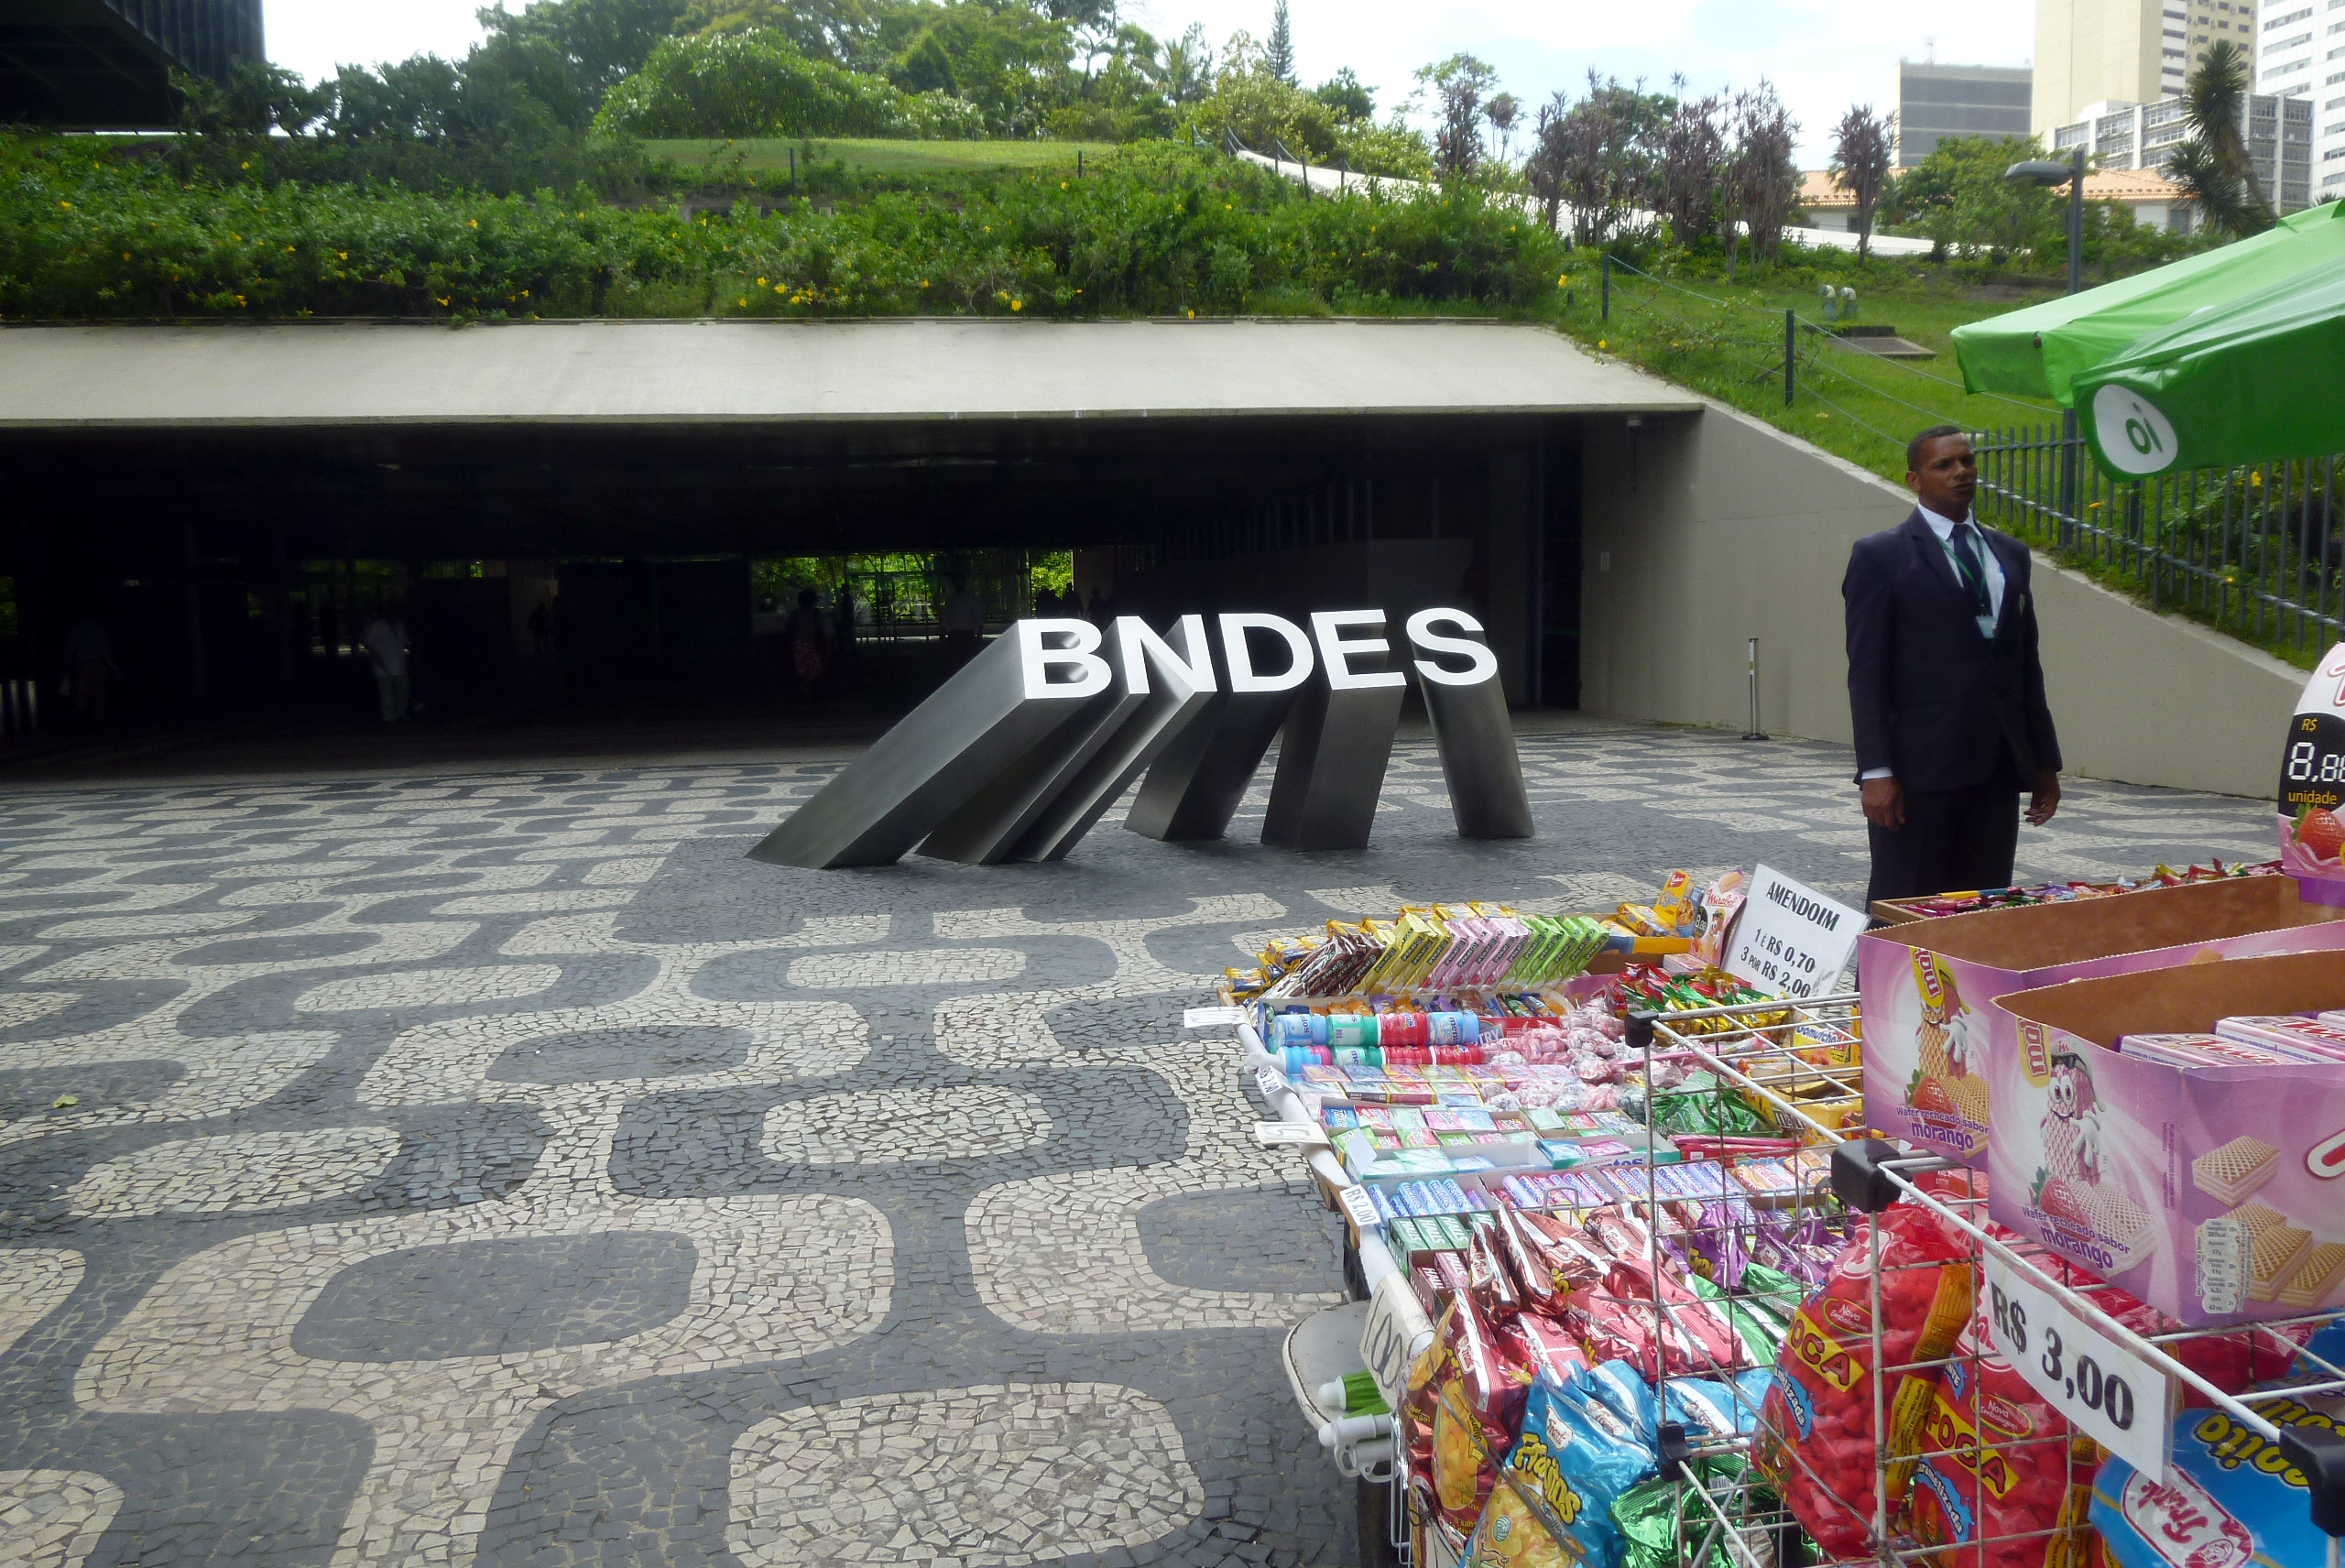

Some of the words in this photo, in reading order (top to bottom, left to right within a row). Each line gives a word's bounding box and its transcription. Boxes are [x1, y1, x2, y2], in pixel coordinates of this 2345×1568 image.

[1017, 606, 1499, 700] BNDES
[2301, 718, 2318, 733] R$
[2288, 790, 2338, 805] unidade
[1706, 888, 1739, 909] Mirabel
[1766, 881, 1840, 932] AMENDOIM
[1754, 928, 1761, 943] 1
[1766, 935, 1784, 957] R$
[1783, 946, 1816, 974] 0,70
[1740, 946, 1749, 962] 3
[1748, 956, 1761, 971] POR
[1761, 962, 1779, 982] R$
[1778, 972, 1812, 998] 2,00
[1896, 1106, 1920, 1119] Wafer
[1921, 1109, 1961, 1126] recheado
[1962, 1118, 1990, 1135] sabor
[1911, 1119, 1975, 1151] morango
[1445, 1180, 1467, 1208] mentos
[1617, 1170, 1643, 1195] mentos
[1344, 1190, 1358, 1203] R$
[1351, 1201, 1376, 1223] 2,00
[1399, 1220, 1423, 1243] HALLS
[1421, 1219, 1446, 1245] HALLS
[1439, 1216, 1469, 1243] HALLS
[2022, 1206, 2048, 1225] Wafer
[2049, 1213, 2097, 1239] recheado
[2098, 1232, 2132, 1256] sabor
[2039, 1224, 2114, 1270] morango
[1442, 1251, 1467, 1277] HALLS
[1422, 1267, 1446, 1290] HALL
[1838, 1303, 1861, 1323] Nova
[1789, 1316, 1851, 1388] OCA
[1992, 1281, 2027, 1356] R$
[2041, 1326, 2134, 1431] 3,00
[1980, 1406, 2018, 1431] Embalagem
[1988, 1399, 2009, 1418] Nova
